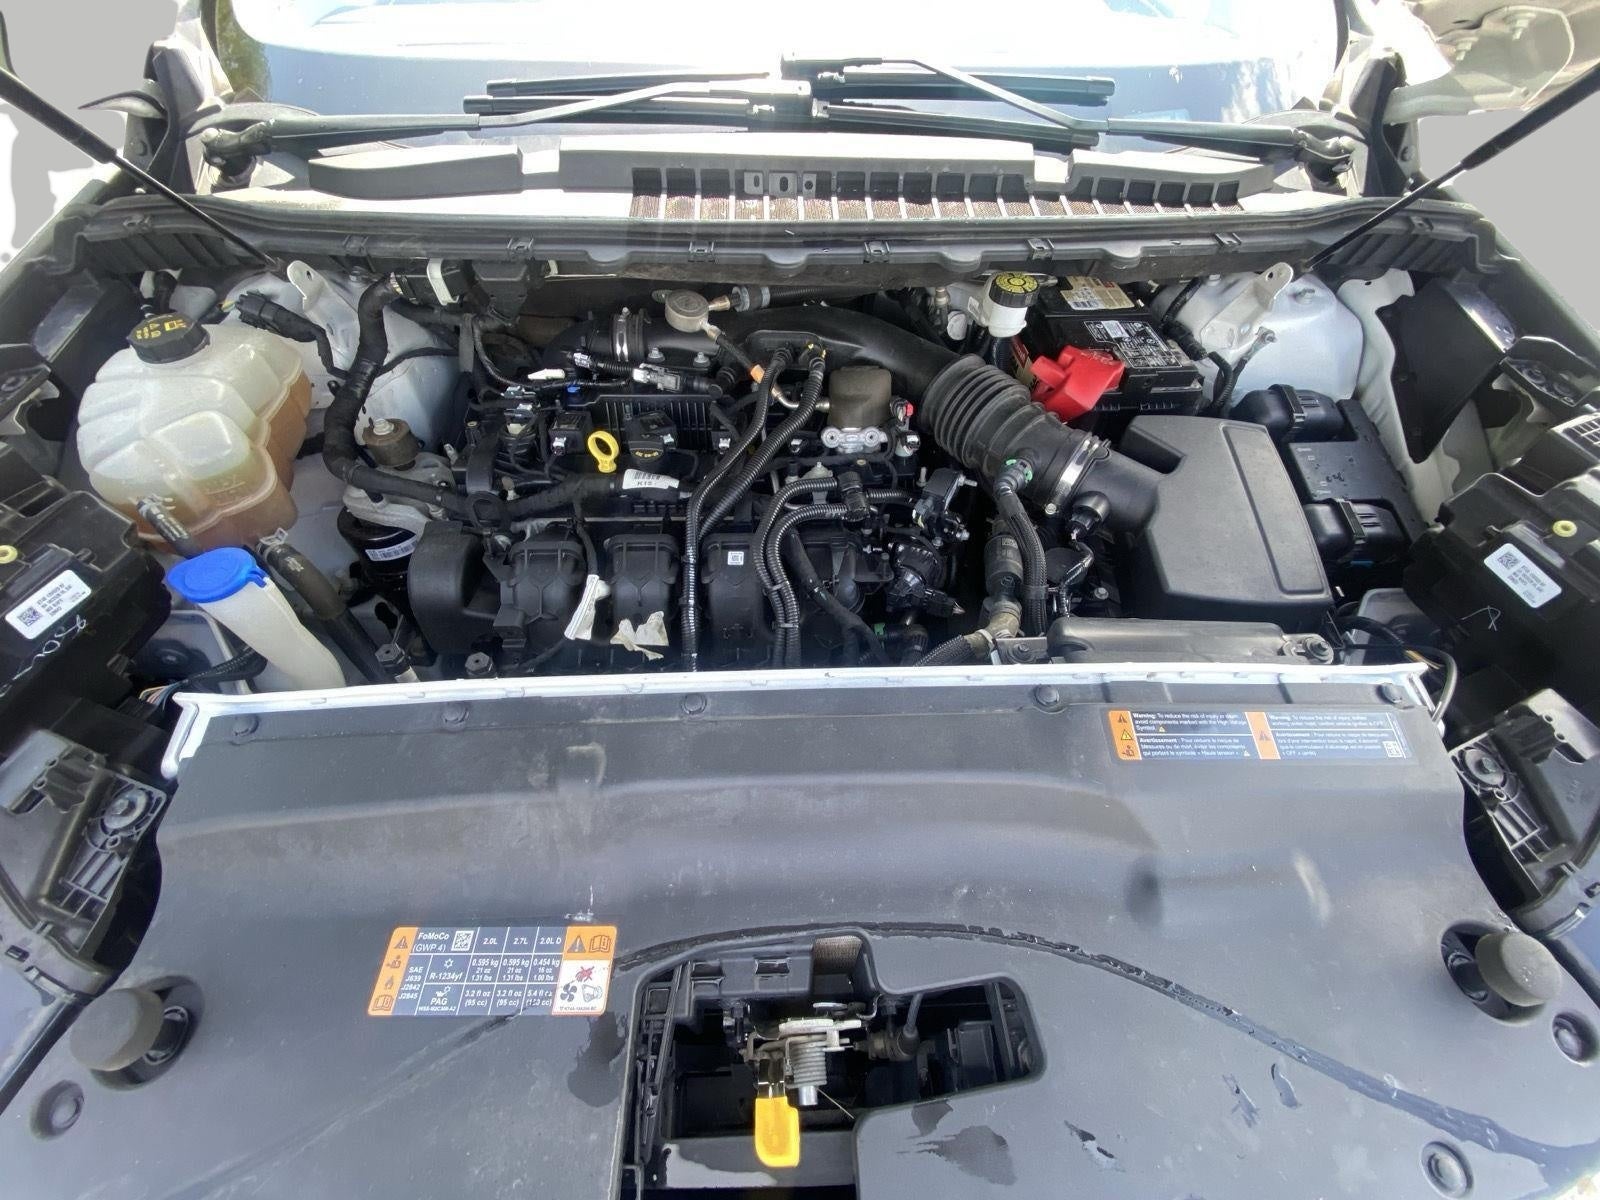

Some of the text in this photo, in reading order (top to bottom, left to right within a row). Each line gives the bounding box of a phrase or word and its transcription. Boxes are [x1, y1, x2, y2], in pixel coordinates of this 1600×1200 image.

[418, 932, 450, 940] FoMoCo
[490, 959, 498, 967] kg
[521, 959, 529, 967] kg
[552, 959, 559, 967] kg
[430, 973, 462, 982] R-1234yf
[477, 999, 487, 1007] cc)
[508, 999, 519, 1007] cc)
